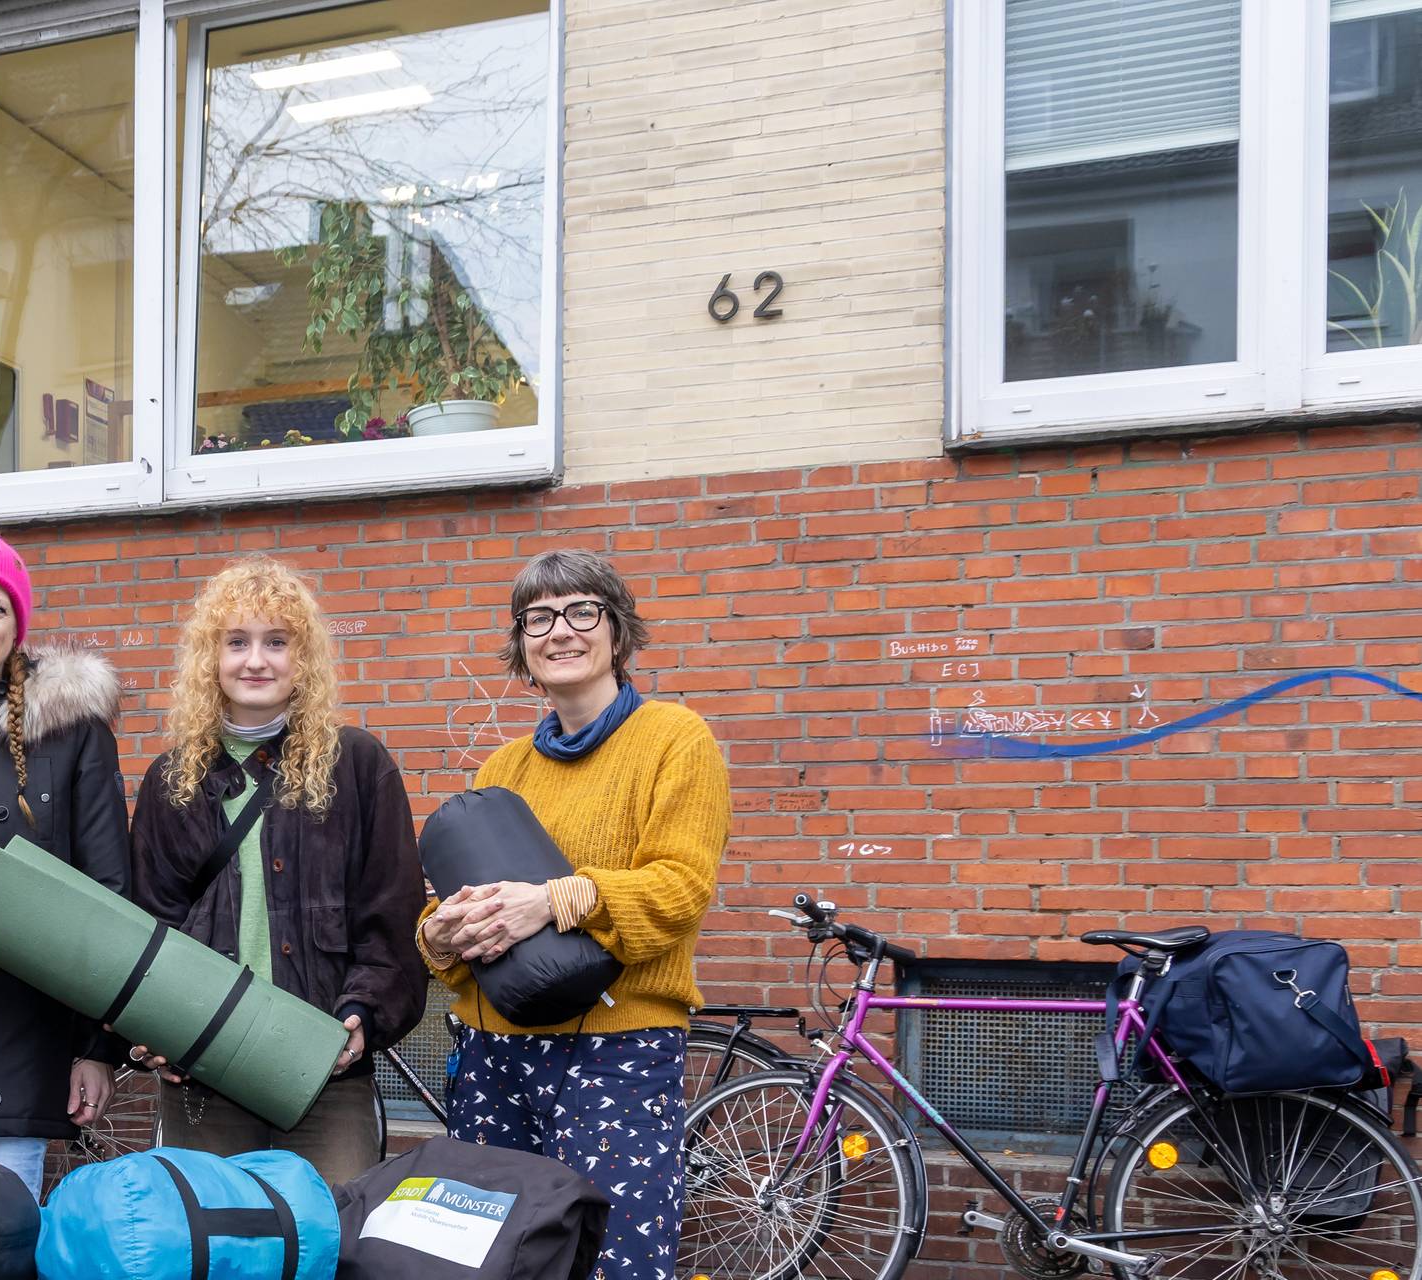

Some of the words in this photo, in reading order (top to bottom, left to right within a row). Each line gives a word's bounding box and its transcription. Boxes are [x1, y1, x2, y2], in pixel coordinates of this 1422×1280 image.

[708, 270, 784, 321] 62
[393, 1186, 427, 1199] STADT
[441, 1192, 506, 1217] MÜNSTER
